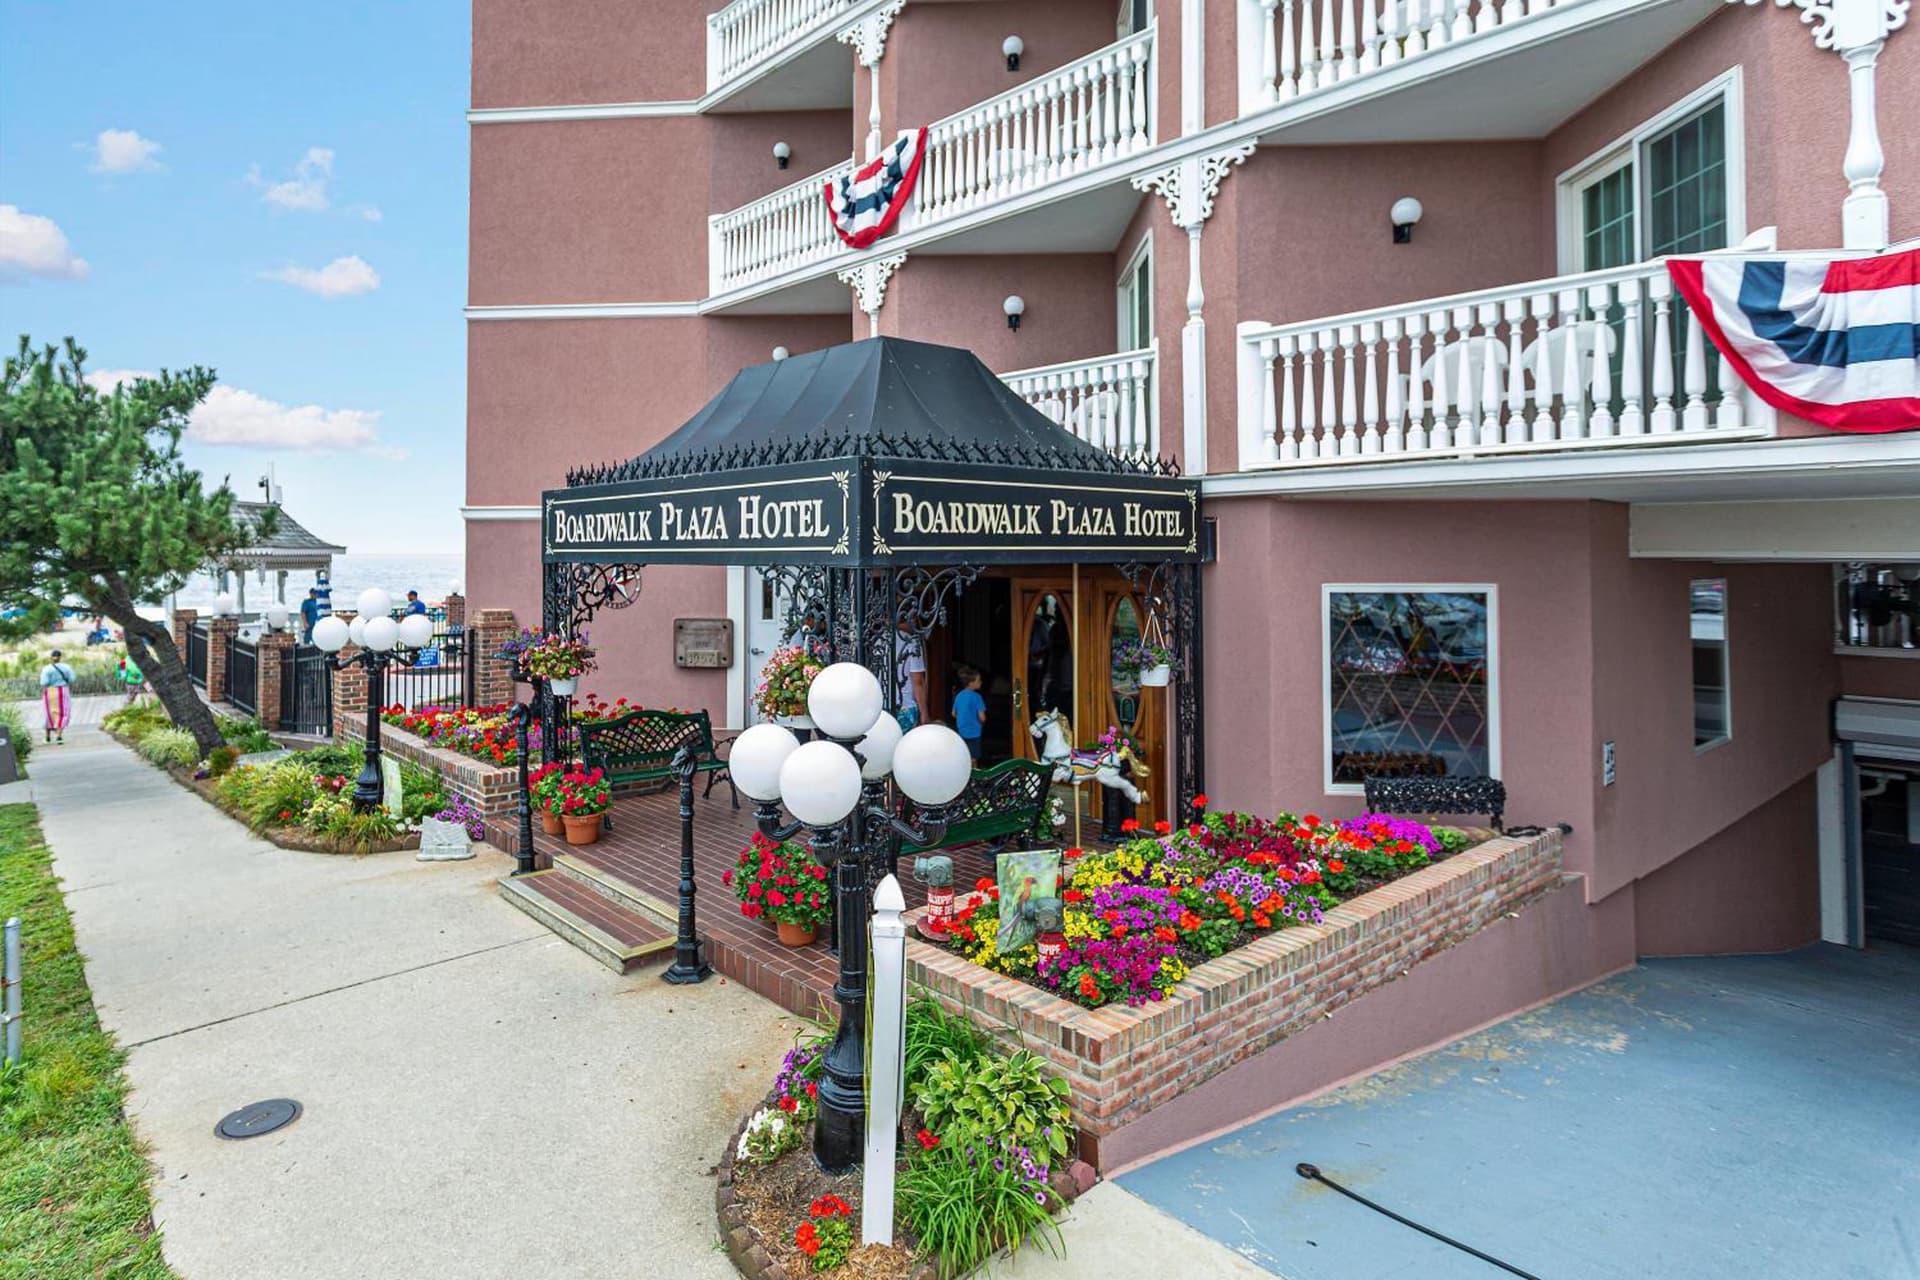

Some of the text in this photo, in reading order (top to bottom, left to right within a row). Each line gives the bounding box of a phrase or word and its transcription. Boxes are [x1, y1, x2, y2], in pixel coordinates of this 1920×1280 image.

[554, 494, 830, 544] BOARDWALK PLAZA HOTEL
[892, 492, 1185, 537] BOARDWALK PLAZA HOTEL
